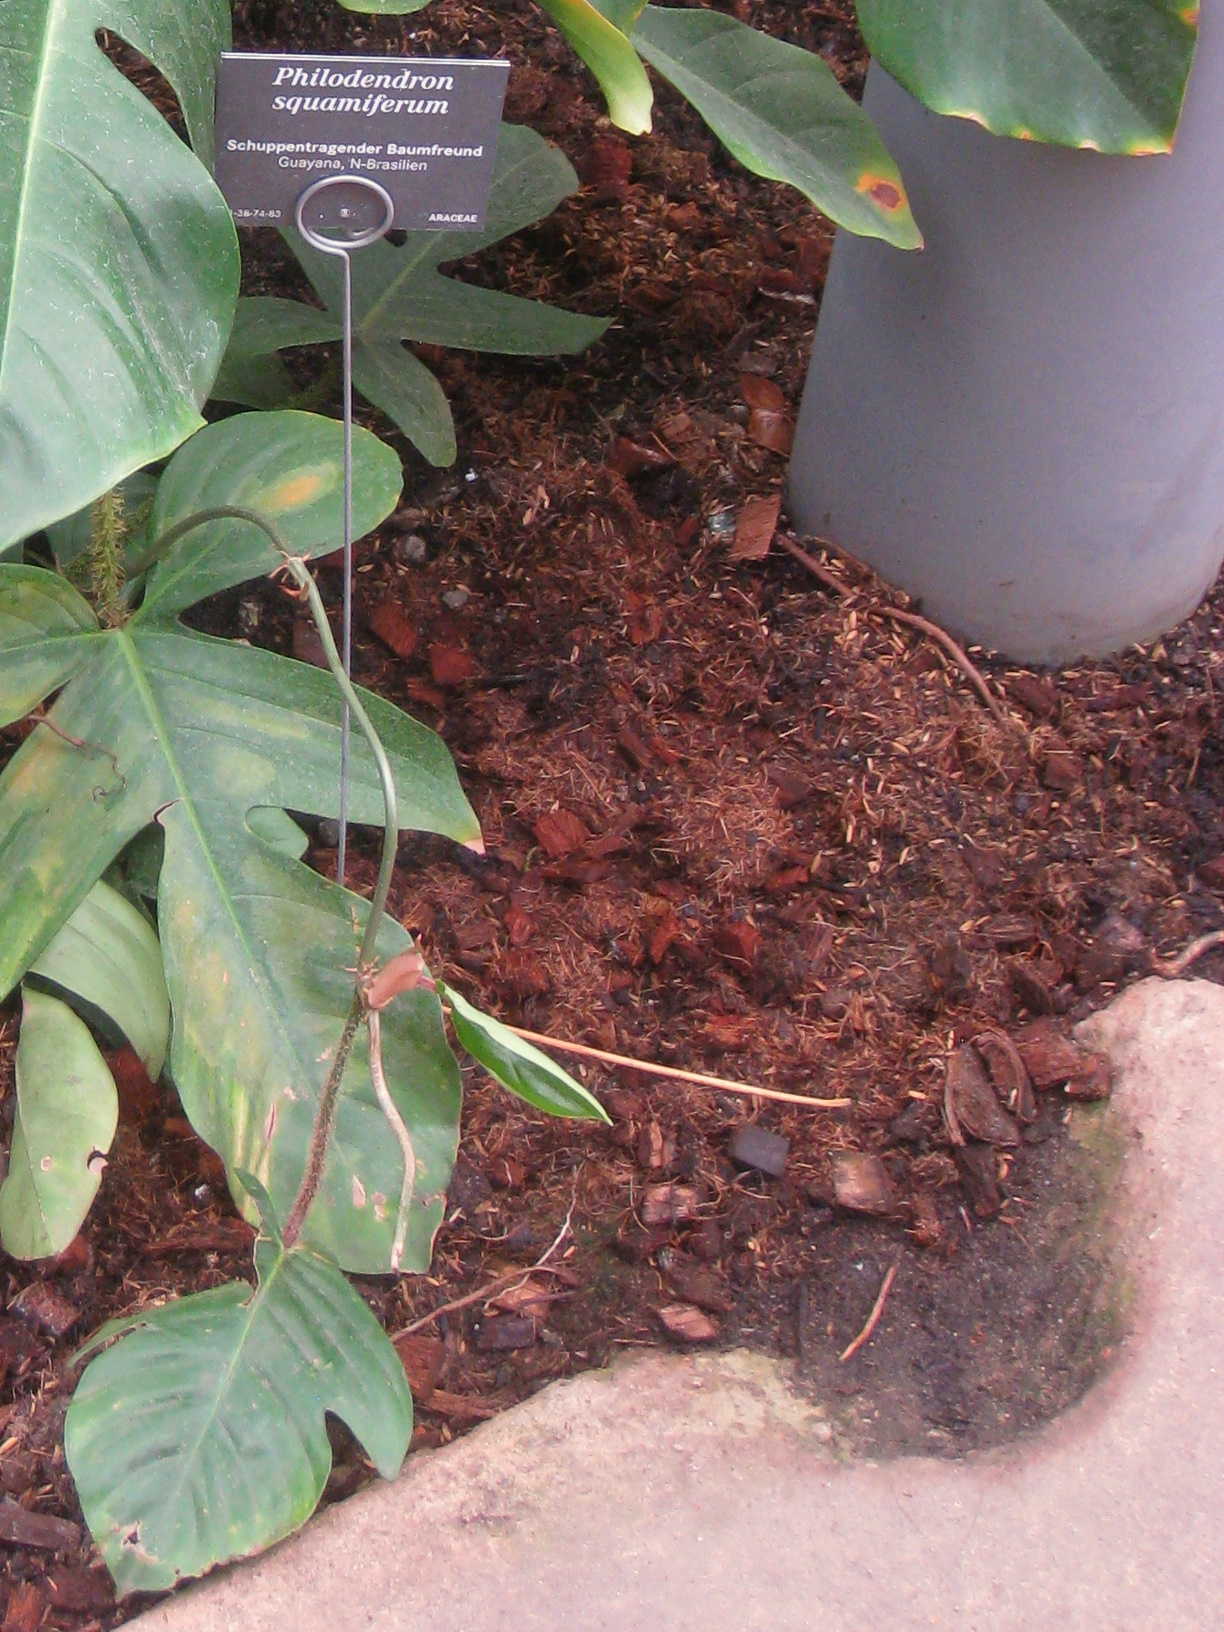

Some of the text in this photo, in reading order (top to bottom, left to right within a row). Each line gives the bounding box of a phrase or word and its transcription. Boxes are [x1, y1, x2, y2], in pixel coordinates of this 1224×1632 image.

[272, 67, 454, 90] Philodendron
[272, 94, 449, 116] squamiferum
[226, 139, 483, 157] Schuppentragender Baumfreund
[278, 156, 428, 171] Guayana, N-Brasilien
[428, 213, 478, 223] ARACEAE
